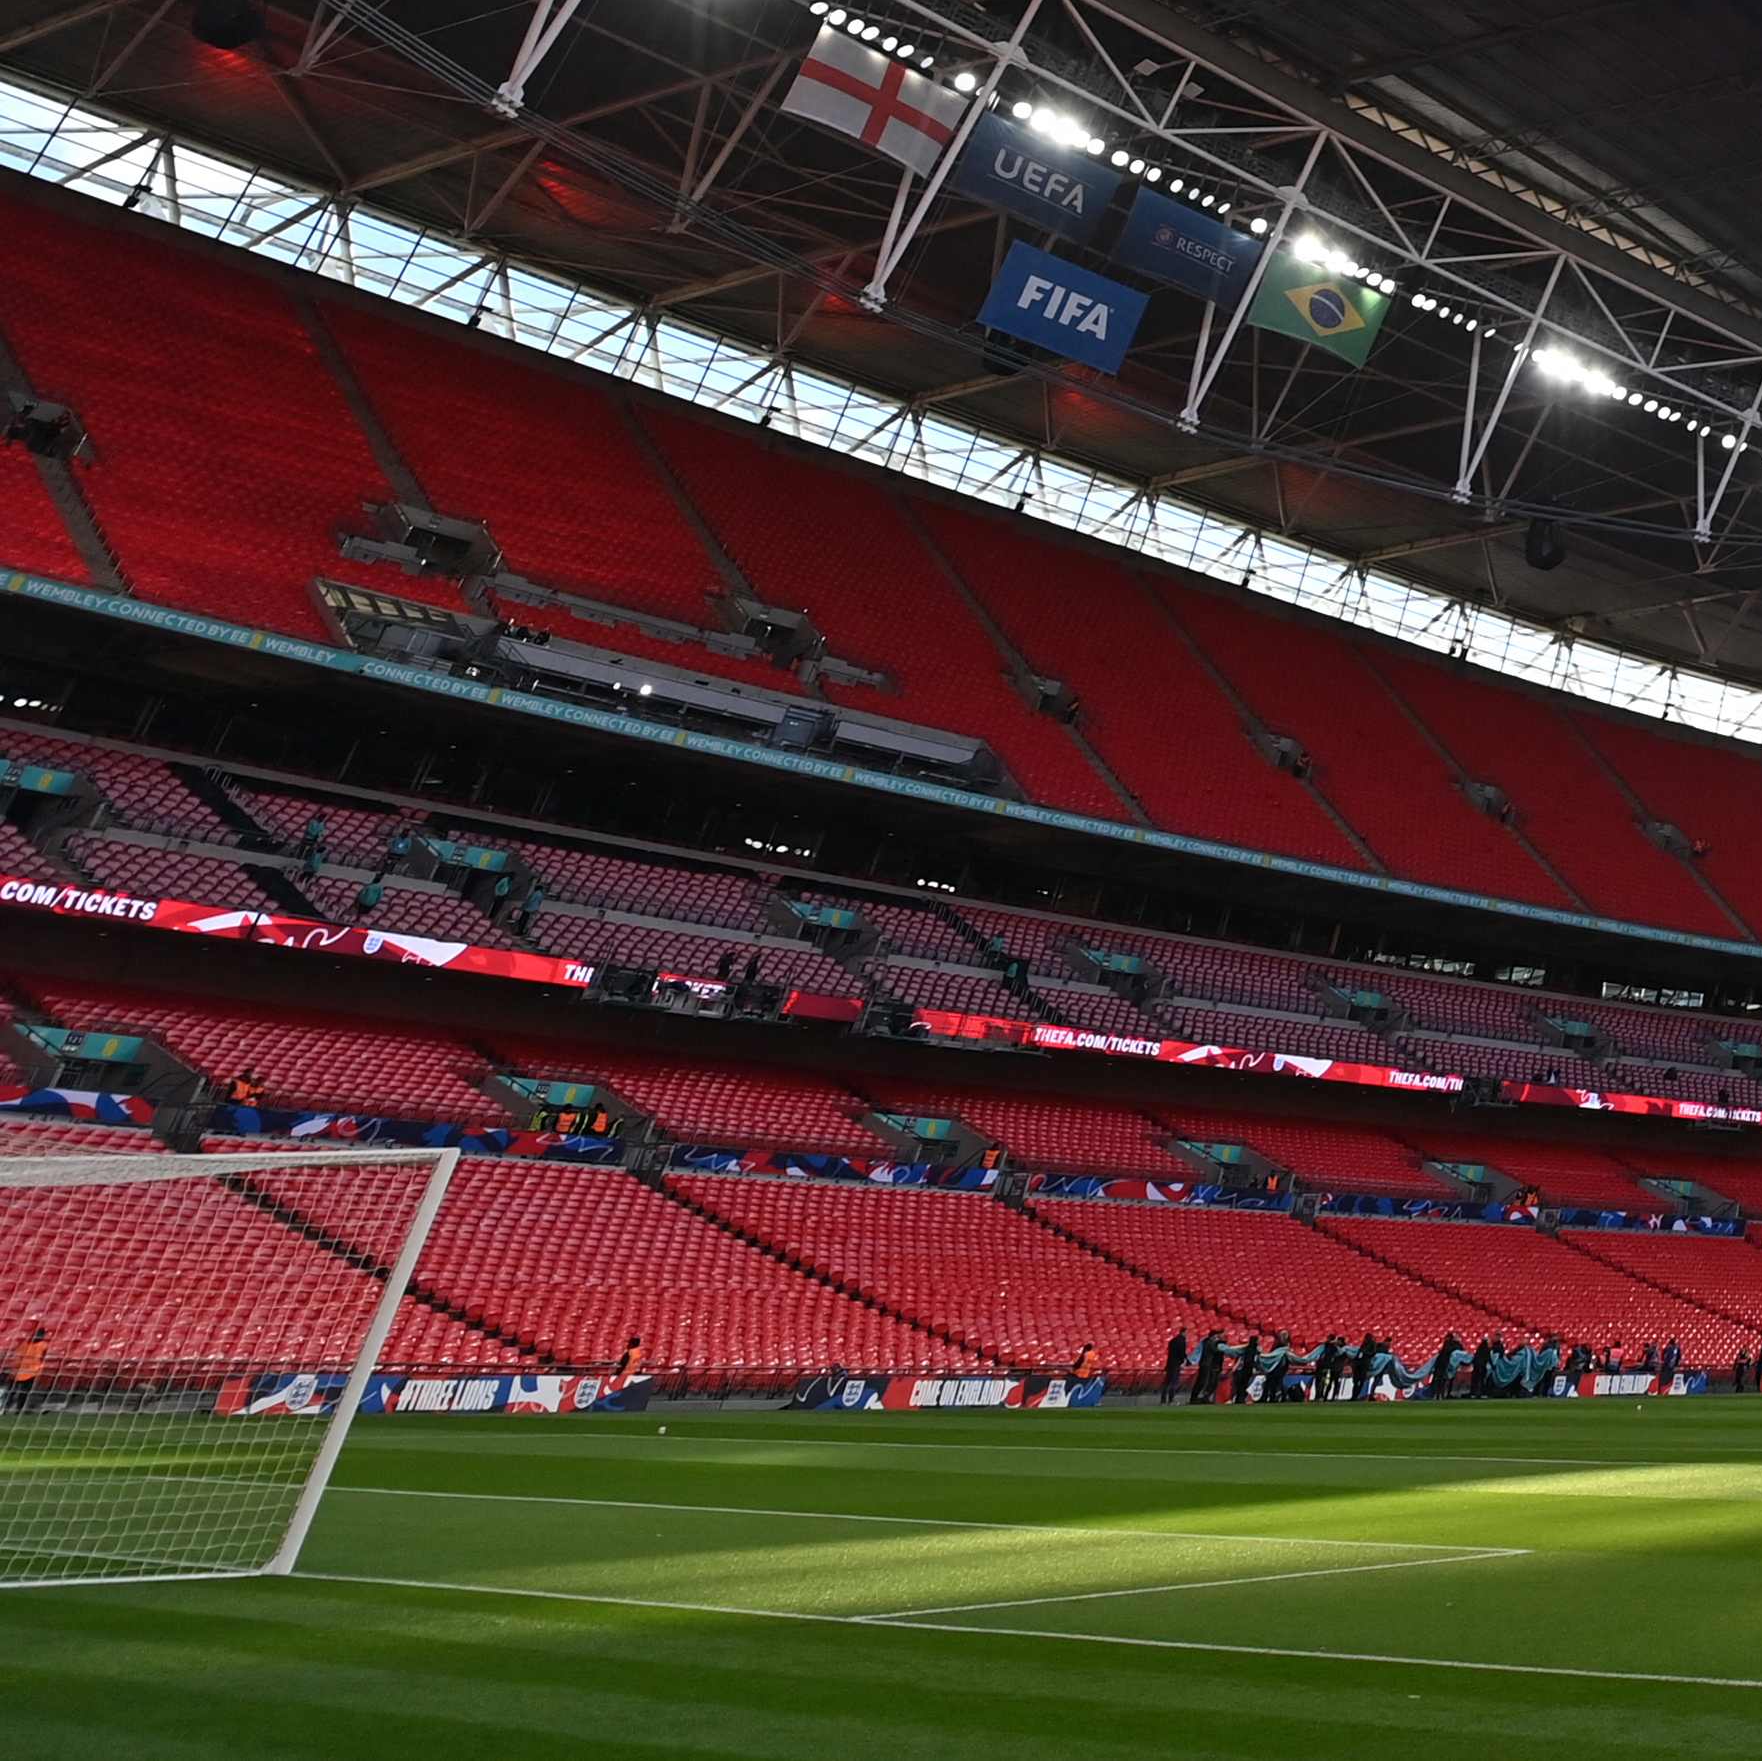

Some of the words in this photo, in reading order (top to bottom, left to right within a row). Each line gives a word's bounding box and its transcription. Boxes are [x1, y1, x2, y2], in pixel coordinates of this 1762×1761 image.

[993, 148, 1085, 214] UEFA
[1176, 237, 1236, 273] RESPECT
[1017, 275, 1111, 341] FIFA
[27, 579, 102, 607] WEMBLEY
[107, 600, 206, 634] CONNECTED
[208, 623, 230, 639] BY
[231, 628, 249, 643] EE
[264, 637, 336, 664] WEMBLEY
[364, 661, 451, 696] CONNECTED
[452, 682, 470, 697] BY
[472, 687, 487, 700] EE
[501, 692, 563, 717] WEMBLEY
[564, 707, 642, 735] CONNECTED
[643, 725, 660, 737] BY
[661, 729, 676, 741] EE
[687, 737, 744, 757] WEMBLEY
[744, 748, 814, 773] CONNECTED
[814, 764, 829, 776] BY
[830, 767, 843, 778] EE
[854, 772, 905, 792] WEMBLEY
[905, 783, 969, 805] CONNECTED
[0, 881, 157, 921] COM/TICKETS
[1032, 1027, 1161, 1057] THEFA.COM/TICKETS
[396, 1379, 455, 1412] #THREE
[449, 1379, 500, 1411] LIONS
[908, 1379, 940, 1407] COME
[954, 1379, 1006, 1406] ENGLAND
